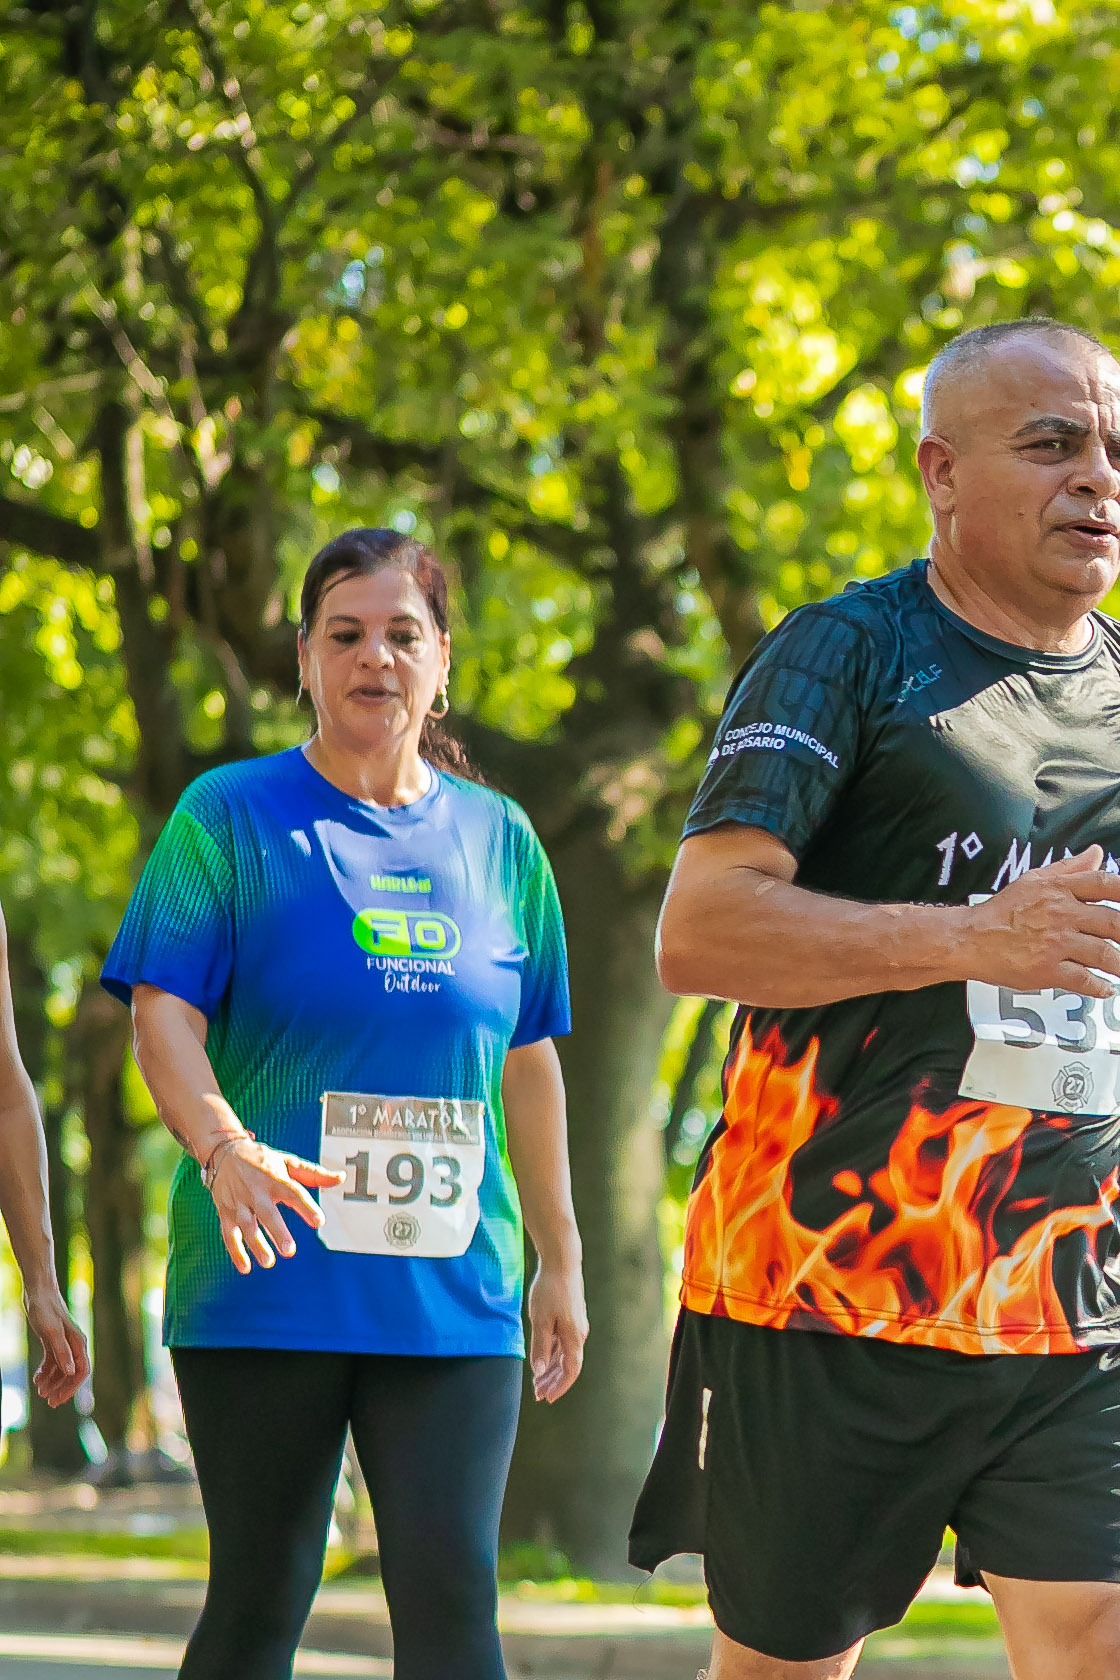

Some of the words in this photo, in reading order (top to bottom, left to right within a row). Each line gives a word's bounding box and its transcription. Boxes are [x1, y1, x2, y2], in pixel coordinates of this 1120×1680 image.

[722, 744, 735, 756] DE
[774, 724, 839, 769] MUNICIPAL
[366, 957, 456, 976] FUNCIONAL
[384, 971, 441, 993] Outdoor
[343, 1150, 463, 1207] 193
